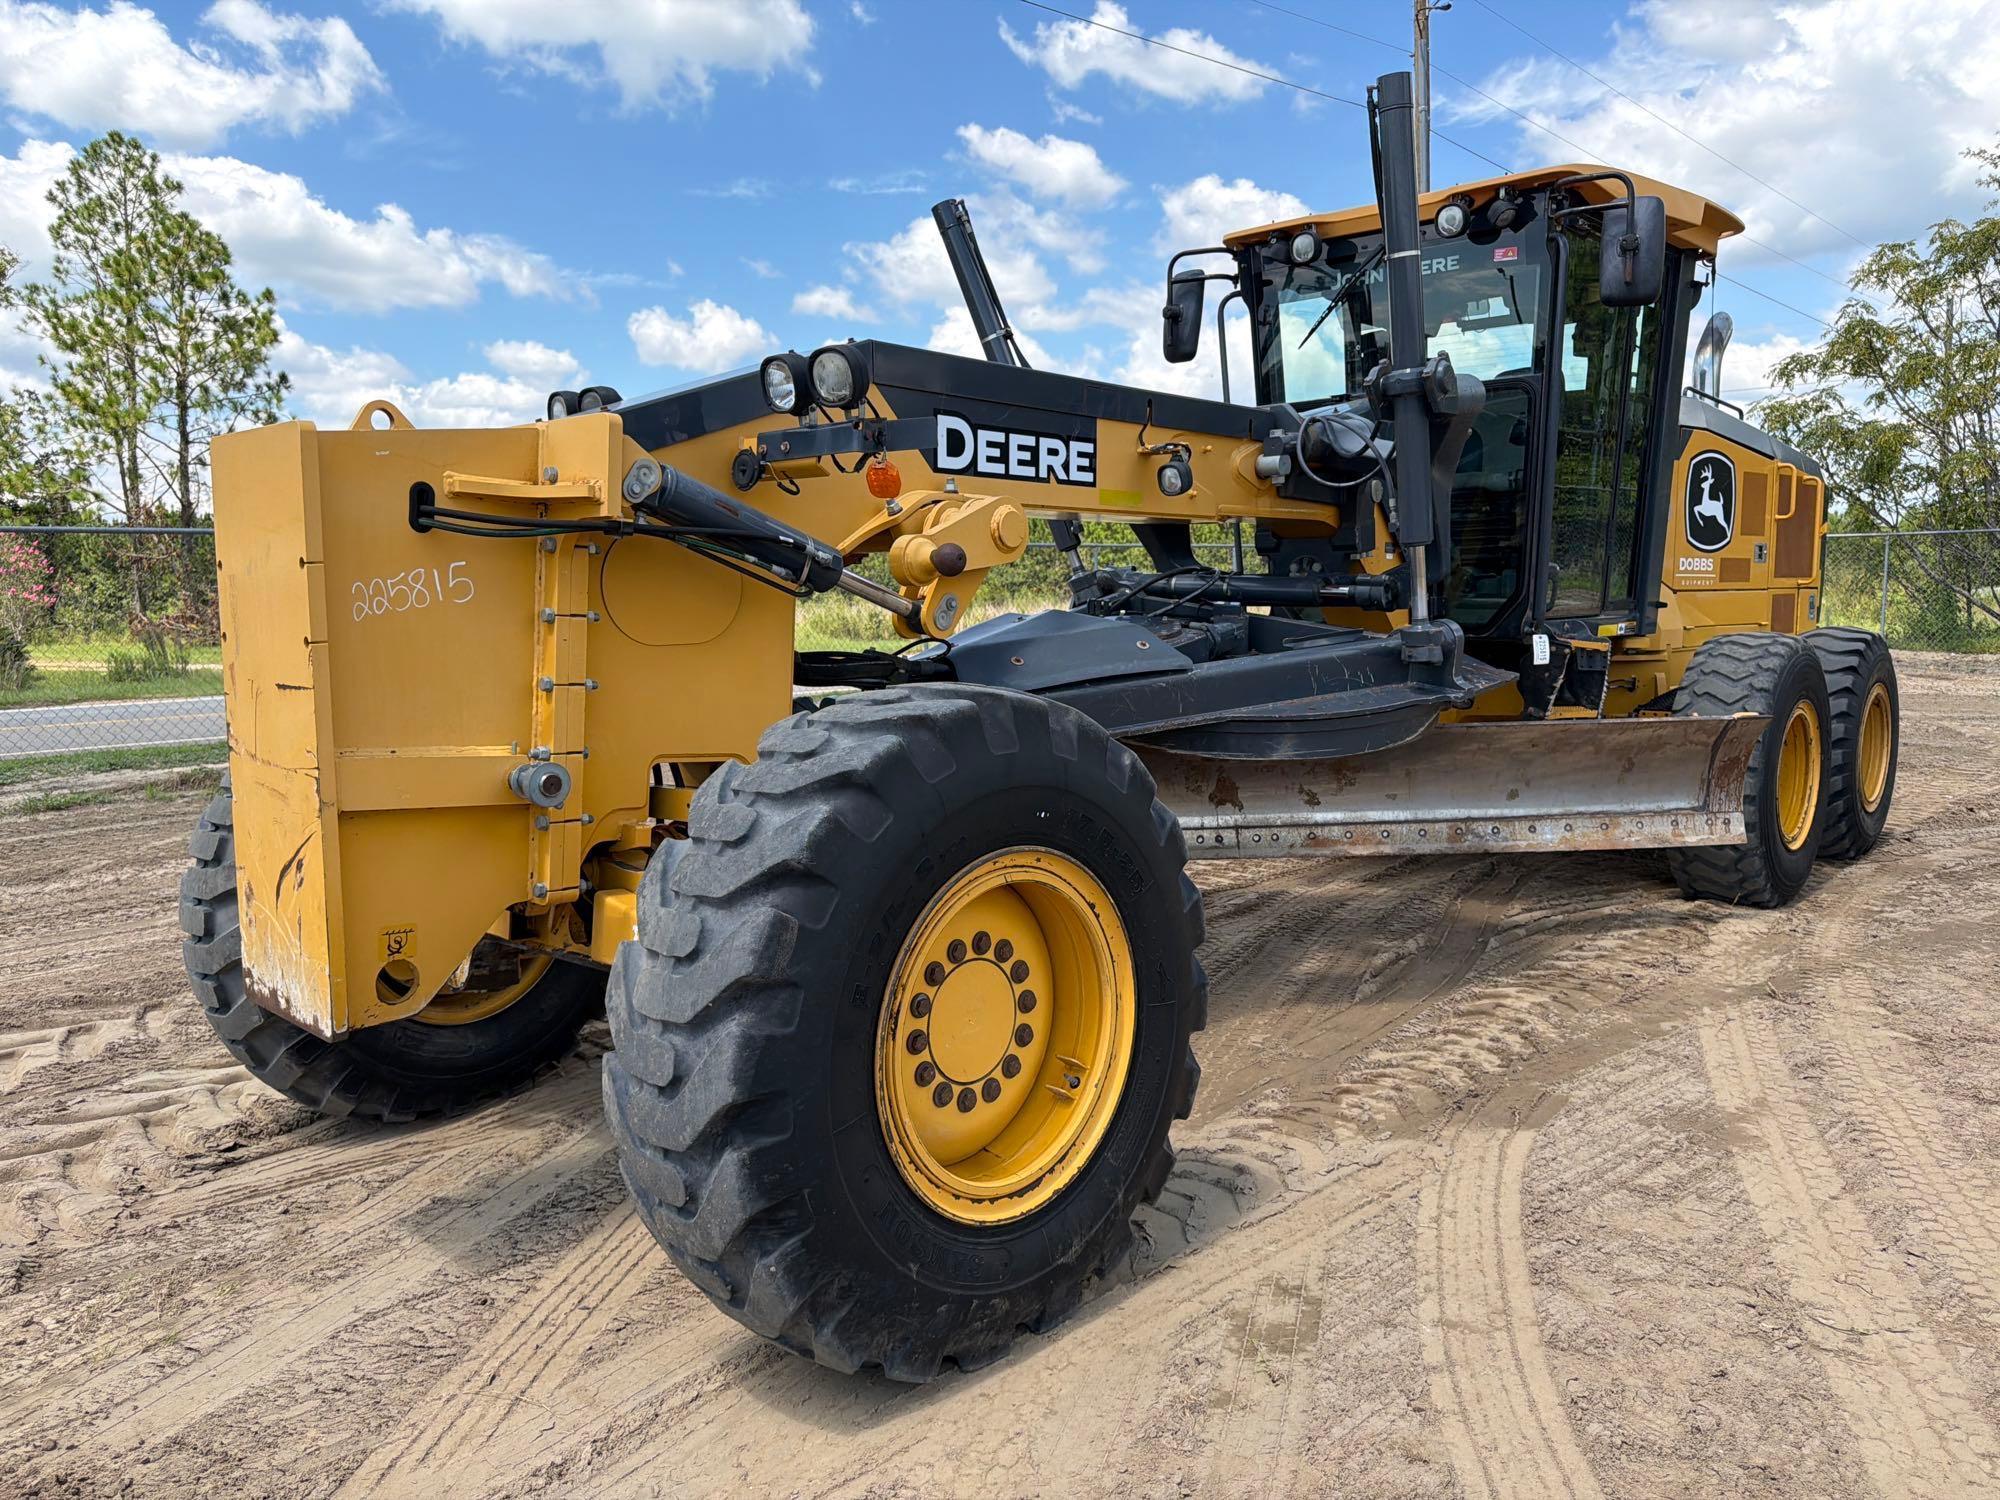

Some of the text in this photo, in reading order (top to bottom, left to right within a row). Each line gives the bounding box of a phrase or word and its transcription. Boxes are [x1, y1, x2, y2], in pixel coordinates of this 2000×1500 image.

[1421, 255, 1460, 275] ERE
[936, 414, 1094, 482] DEERE
[1679, 557, 1714, 571] DOBBS
[352, 561, 474, 621] 225815
